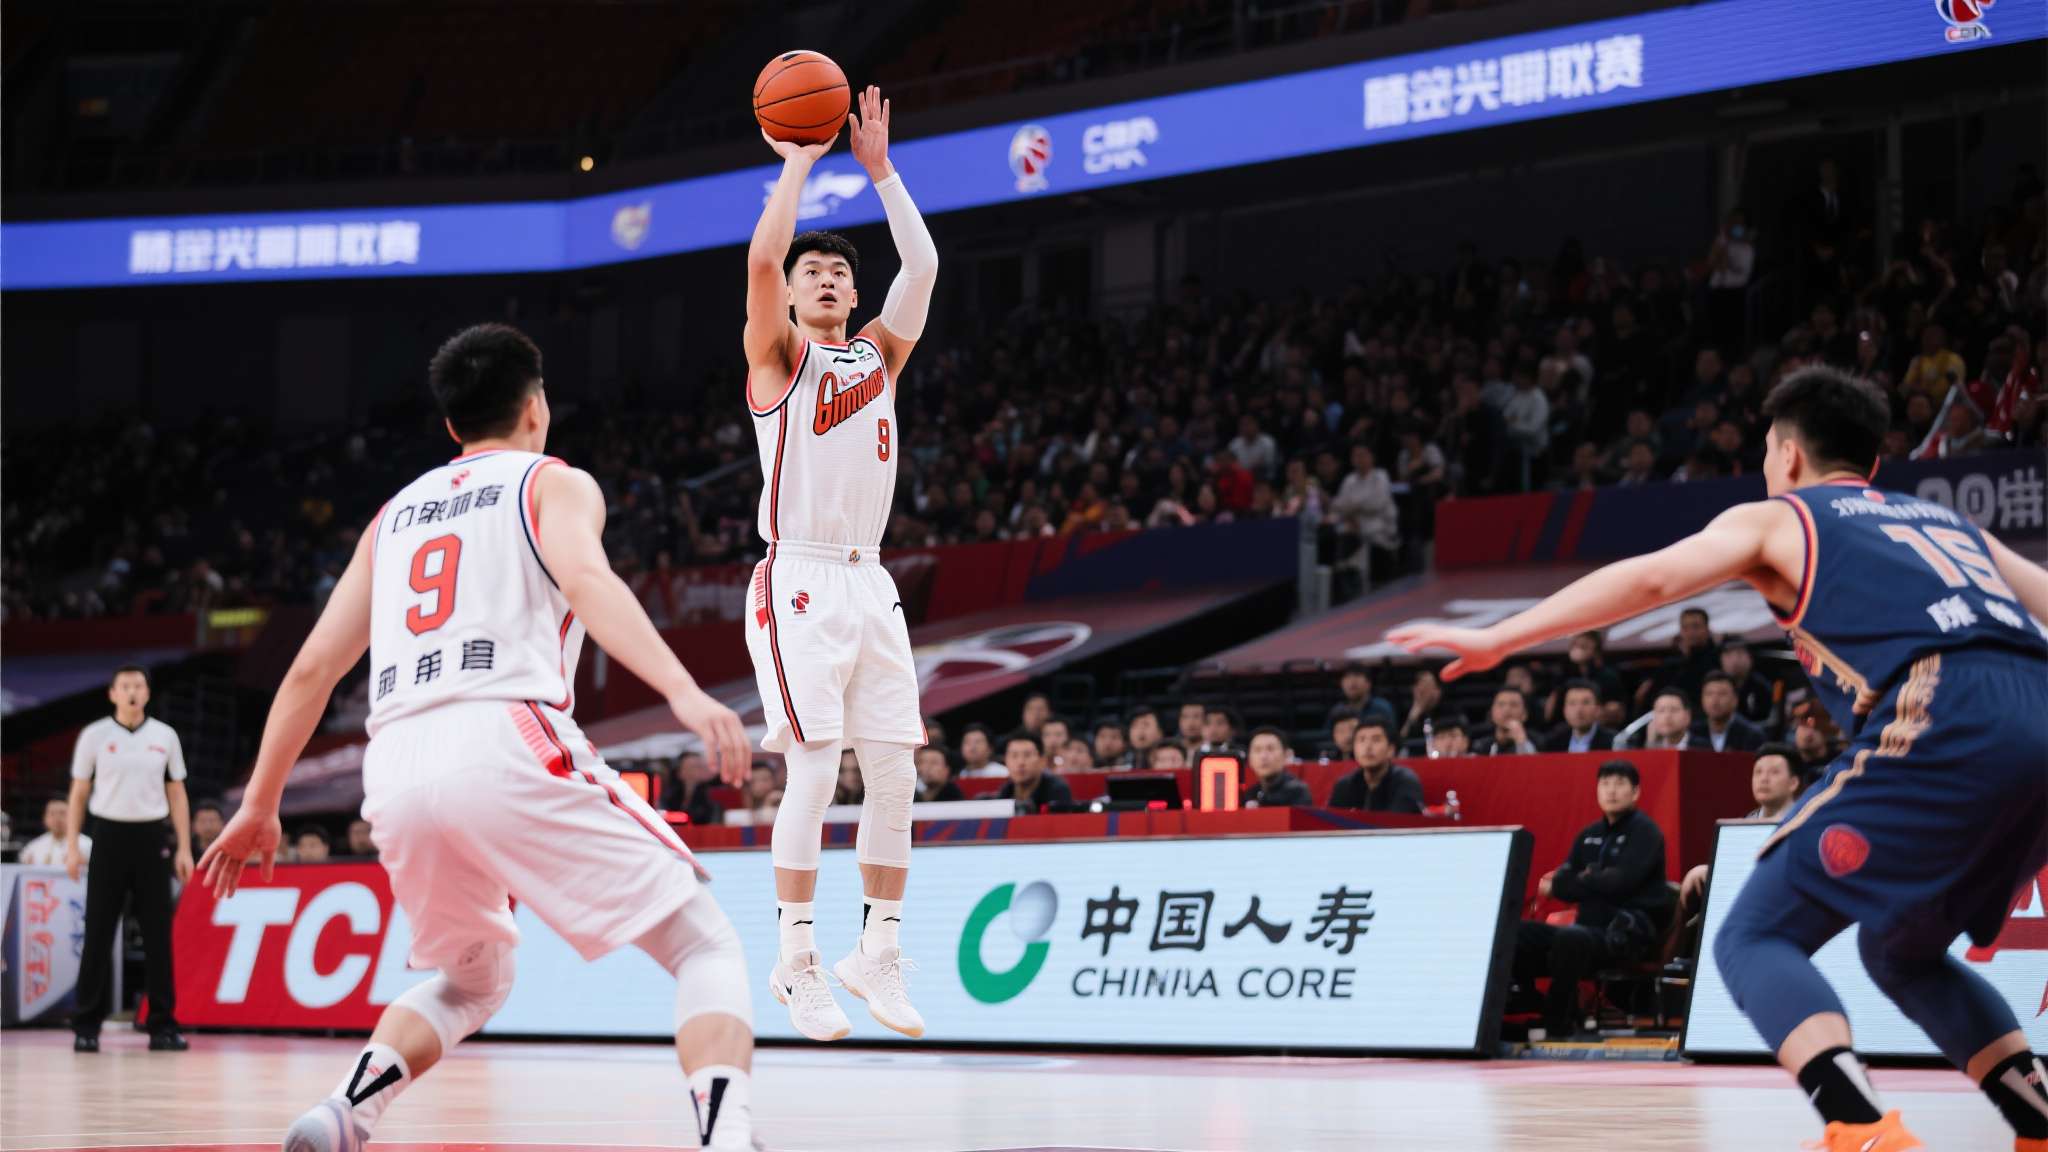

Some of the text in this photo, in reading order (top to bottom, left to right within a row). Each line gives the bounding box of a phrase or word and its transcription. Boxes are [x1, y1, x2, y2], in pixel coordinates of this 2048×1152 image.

[878, 418, 890, 462] 9
[406, 533, 463, 636] 9
[211, 881, 440, 1009] TCL
[1080, 885, 1375, 957] 中国人寿
[1238, 967, 1357, 998] CORE
